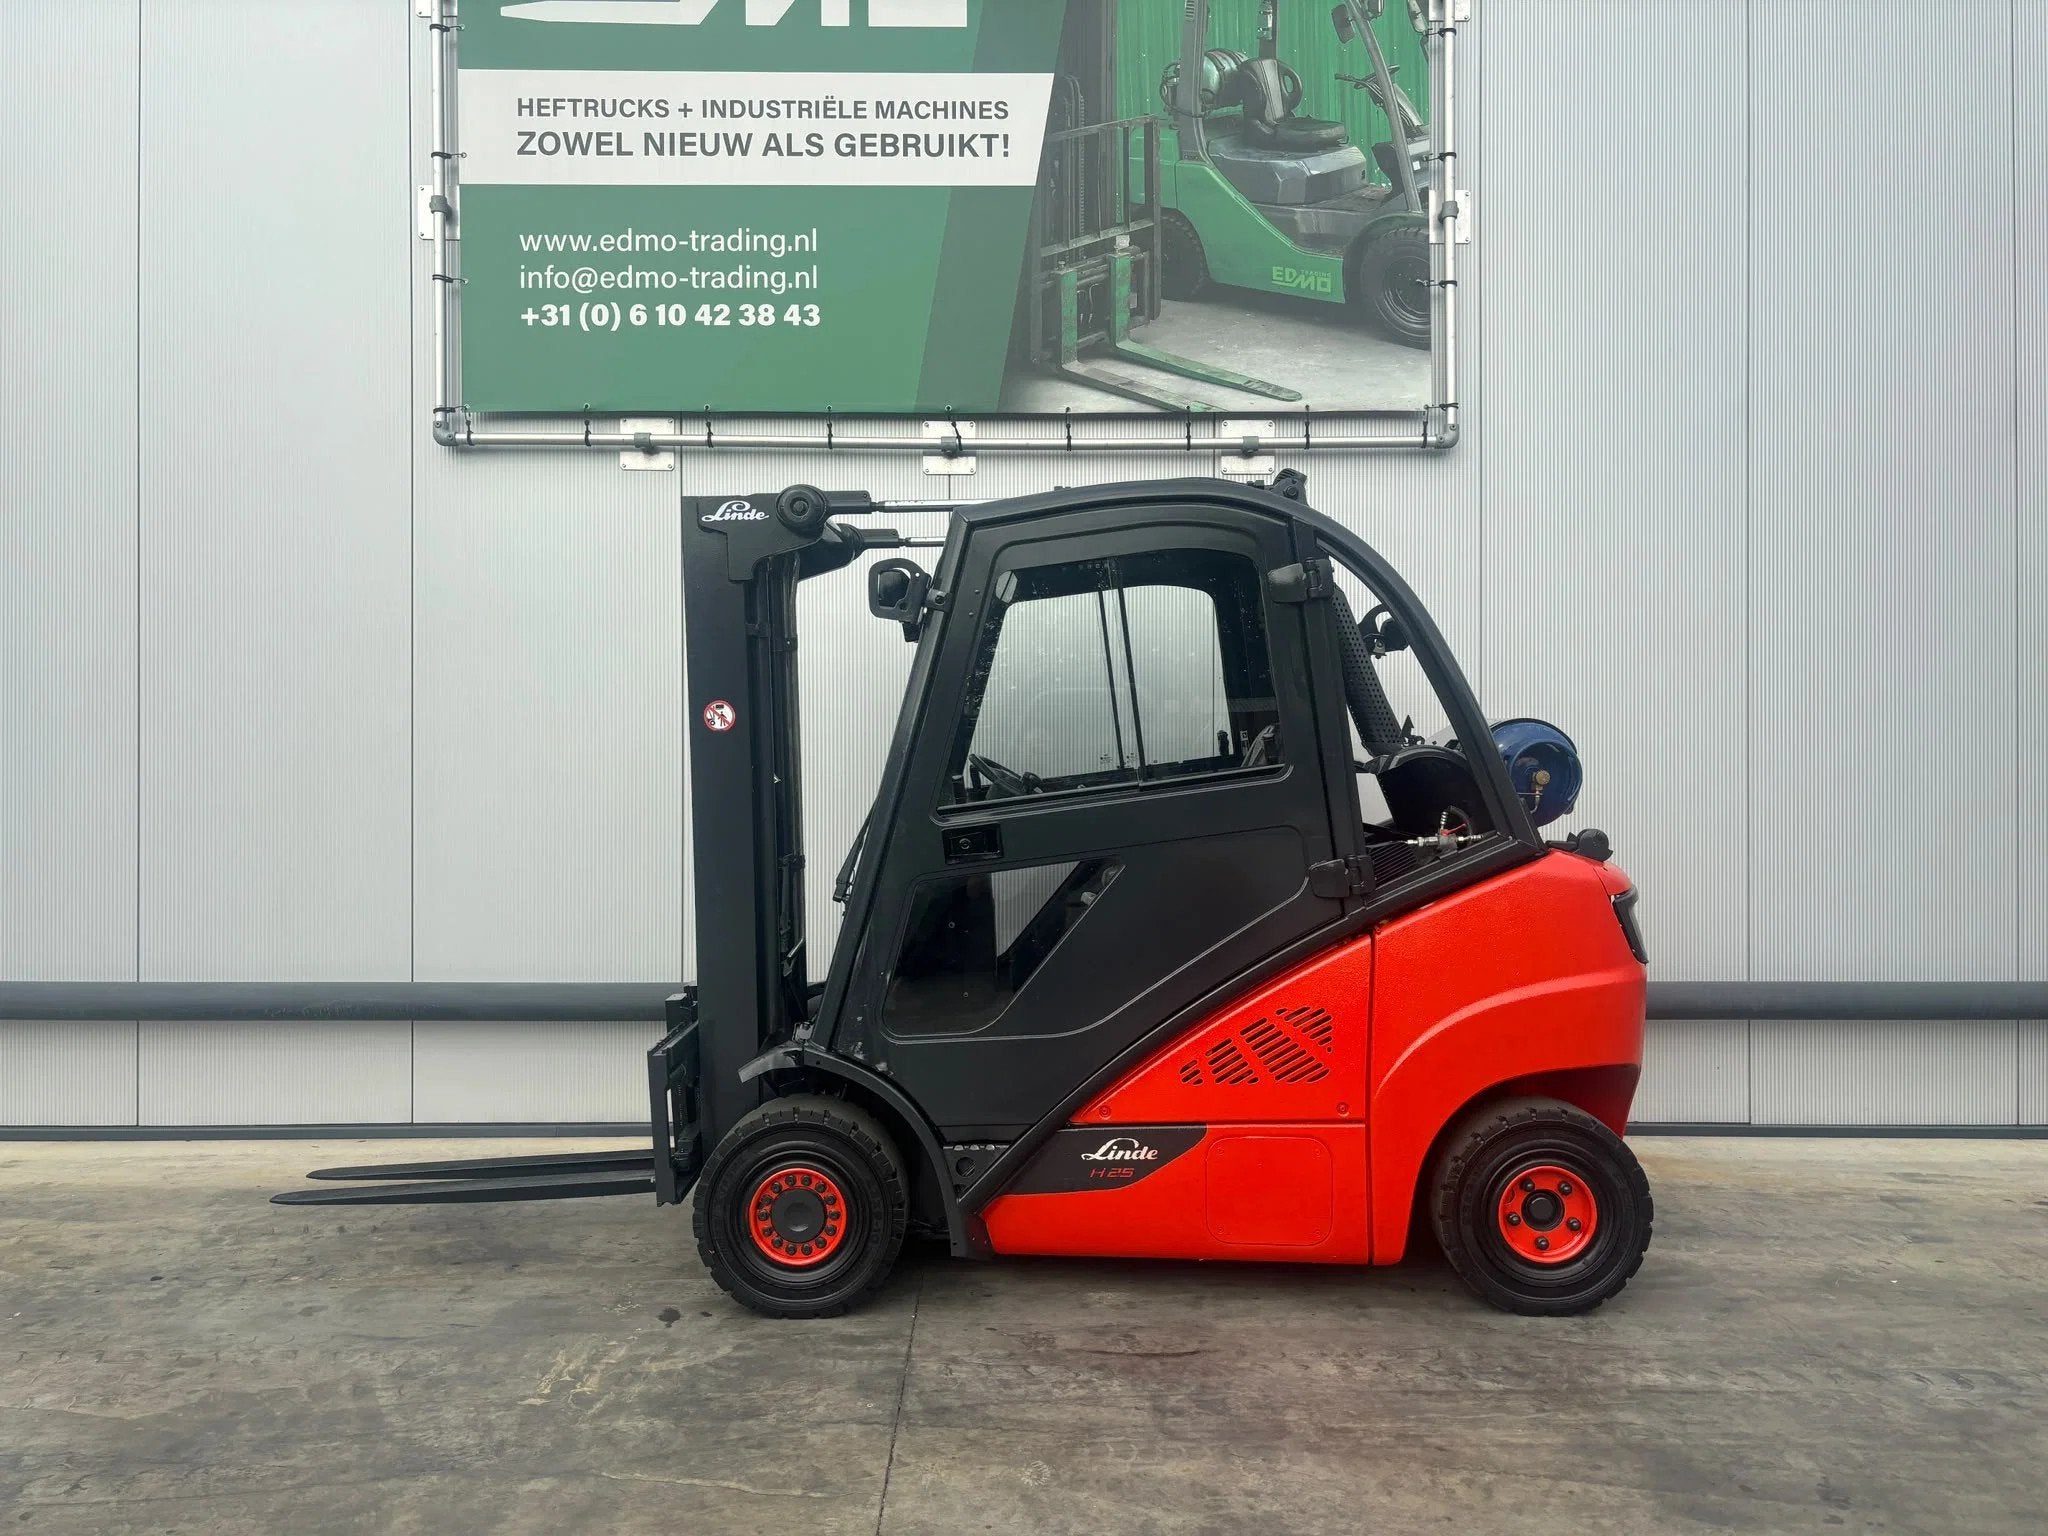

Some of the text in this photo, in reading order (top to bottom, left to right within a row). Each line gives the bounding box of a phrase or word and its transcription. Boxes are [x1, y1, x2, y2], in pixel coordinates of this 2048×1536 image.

[517, 95, 1009, 120] HEFTRUCKS + INDUSTRIËLE MACHINES
[517, 131, 1009, 158] ZOWEL NIEUW ALS GEBRUIKT!
[519, 228, 817, 258] www.edmo-trading.nl
[520, 265, 818, 294] info@edmo-trading.nl
[1272, 266, 1331, 293] EDMO
[521, 302, 821, 331] +31 (0) 6 10 42 38 43
[701, 500, 770, 522] Linde
[1081, 1137, 1158, 1160] Linde
